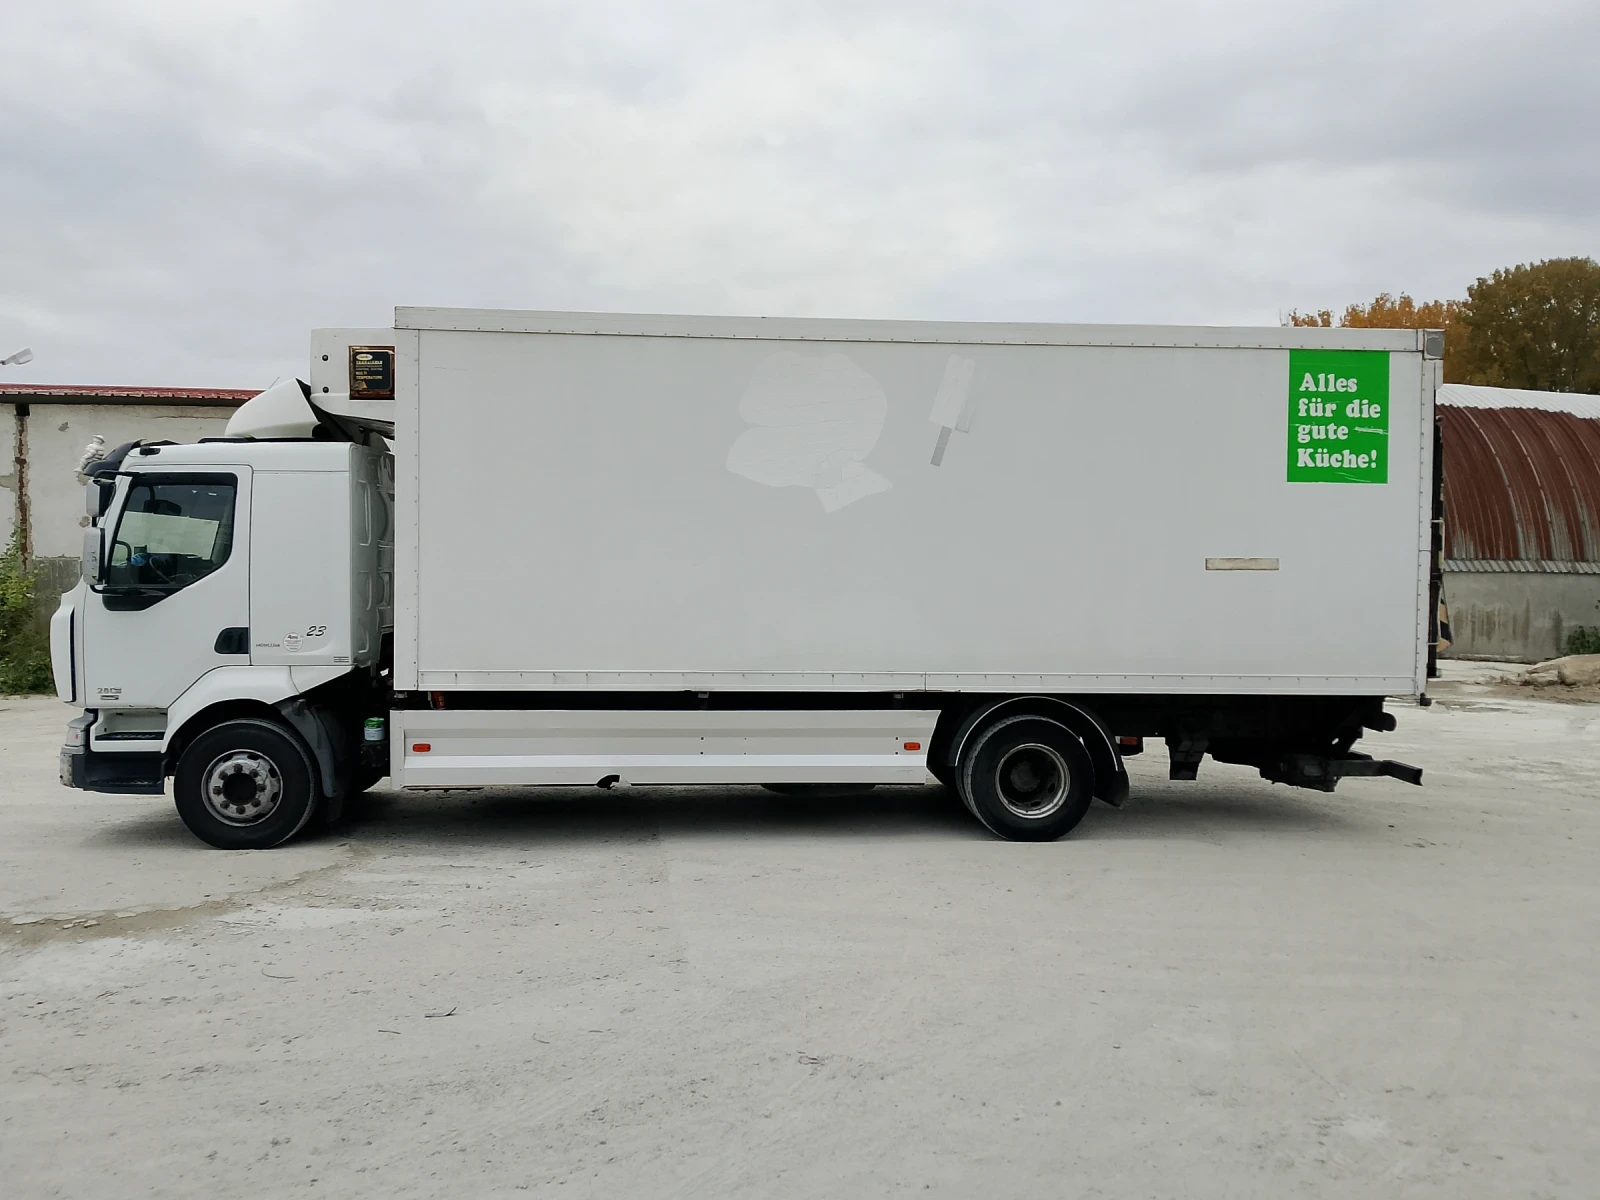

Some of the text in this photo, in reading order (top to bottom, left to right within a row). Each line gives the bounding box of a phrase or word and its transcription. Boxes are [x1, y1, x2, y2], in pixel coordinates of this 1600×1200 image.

[1299, 372, 1358, 392] Alles
[1298, 397, 1381, 418] für die
[1297, 422, 1349, 443] gute
[1297, 448, 1377, 468] Küche!
[306, 625, 327, 637] 23
